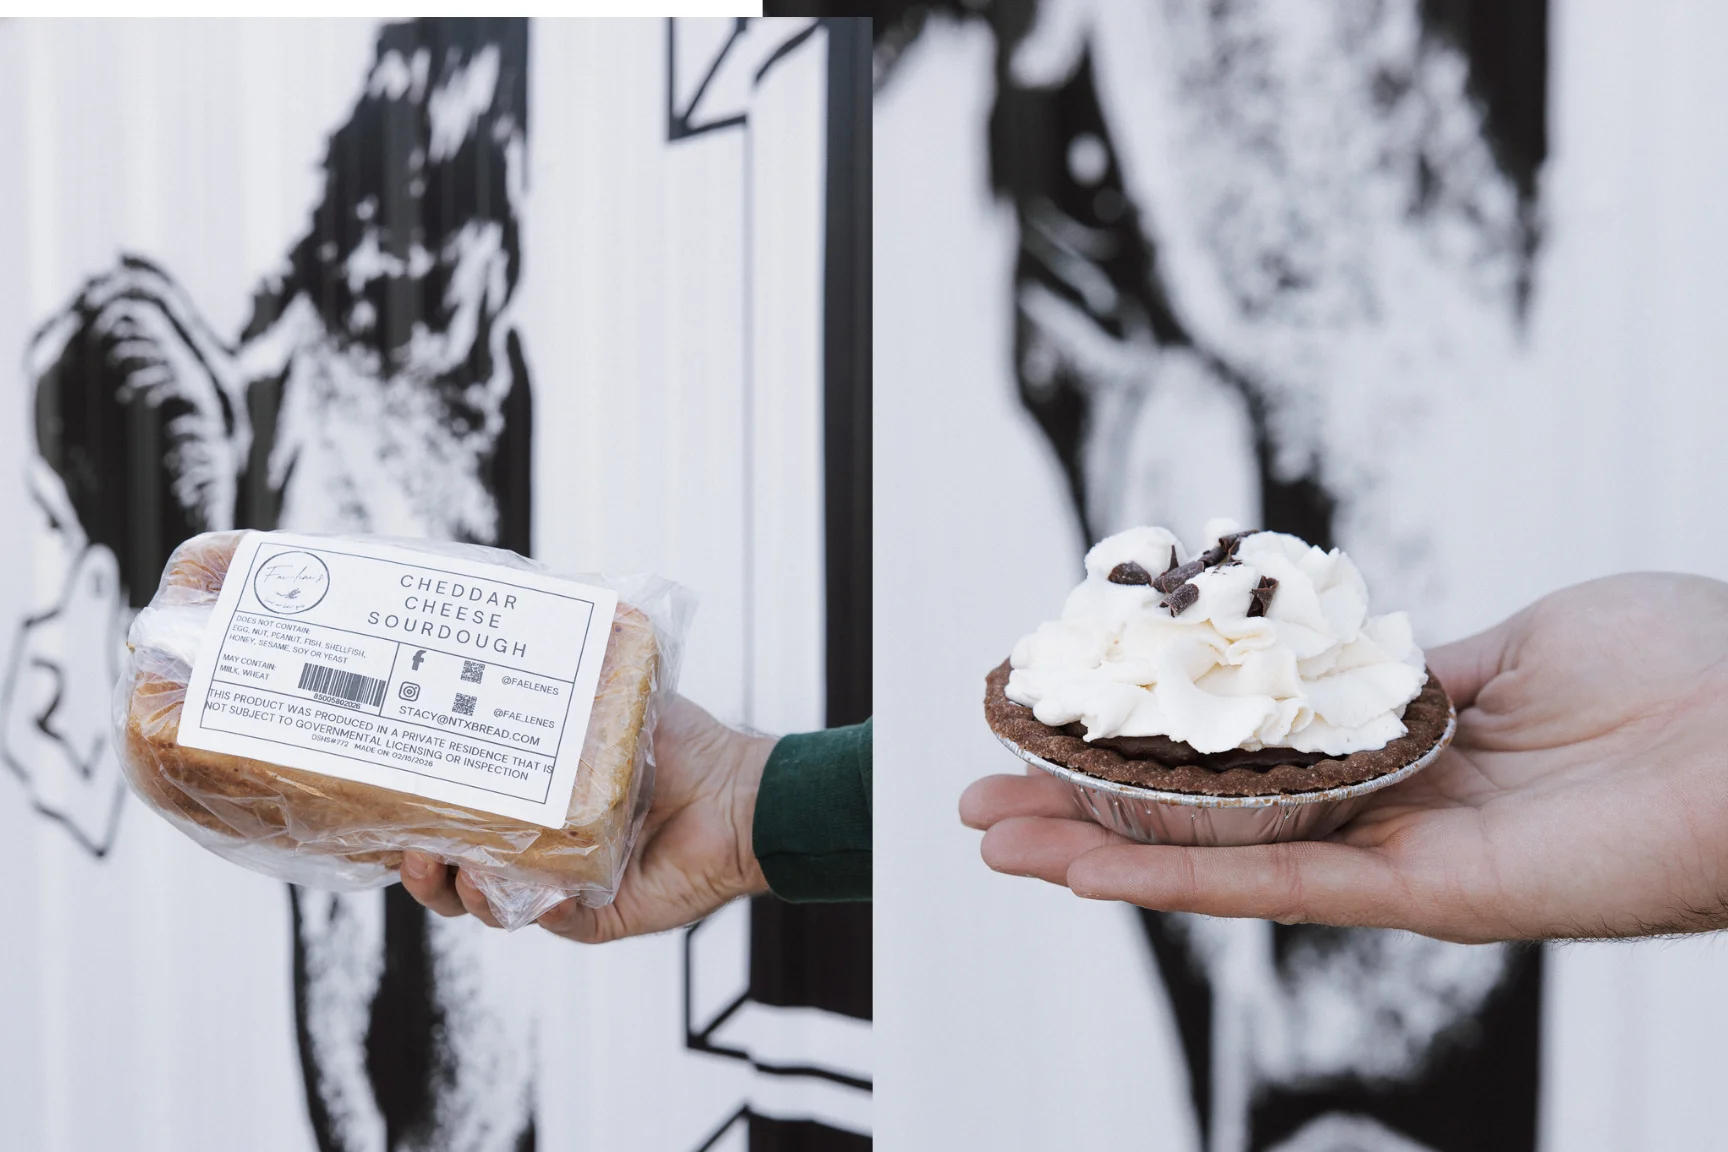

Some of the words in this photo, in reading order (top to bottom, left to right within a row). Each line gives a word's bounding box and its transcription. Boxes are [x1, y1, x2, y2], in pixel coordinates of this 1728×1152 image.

[400, 574, 517, 610] CHEDDAR
[236, 615, 257, 625] DOES
[257, 619, 274, 628] NOT
[275, 622, 311, 635] CONTAIN:
[405, 596, 501, 628] CHEESE
[229, 634, 256, 646] HONEY,
[258, 640, 291, 653] SESAME,
[292, 646, 309, 655] SOY
[310, 649, 322, 658] OR
[323, 652, 348, 665] YEAST
[232, 625, 250, 634] EGG,
[252, 628, 269, 638] NUT,
[271, 632, 302, 645] PEANUT,
[325, 642, 366, 658] SHELLFISH,
[368, 611, 526, 657] SOURDOUGH
[223, 653, 239, 663] MAY
[240, 657, 276, 670] CONTAIN:
[242, 669, 270, 680] WHEAT
[501, 675, 559, 696] @FAELENES
[208, 688, 231, 700] THIS
[233, 693, 285, 711] PRODUCT
[287, 704, 312, 717] WAS
[314, 710, 374, 731] PRODUCED
[377, 724, 389, 735] IN
[391, 728, 399, 738] A
[402, 730, 446, 748] PRIVATE
[449, 740, 508, 763] RESIDENCE
[512, 756, 541, 771] THAT
[543, 764, 554, 774] IS
[399, 705, 540, 747] STACY@NTXBREAD.COM
[493, 708, 555, 729] @FAE_LENES
[205, 701, 227, 712] NOT
[229, 705, 276, 723] SUBJECT
[278, 716, 293, 726] TO
[295, 719, 382, 747] GOVERNMENTAL
[385, 740, 443, 760] LICENSING
[445, 753, 461, 765] OR
[463, 757, 529, 781] INSPECTION
[311, 734, 349, 747] DSHS#772
[354, 743, 375, 754] MADE
